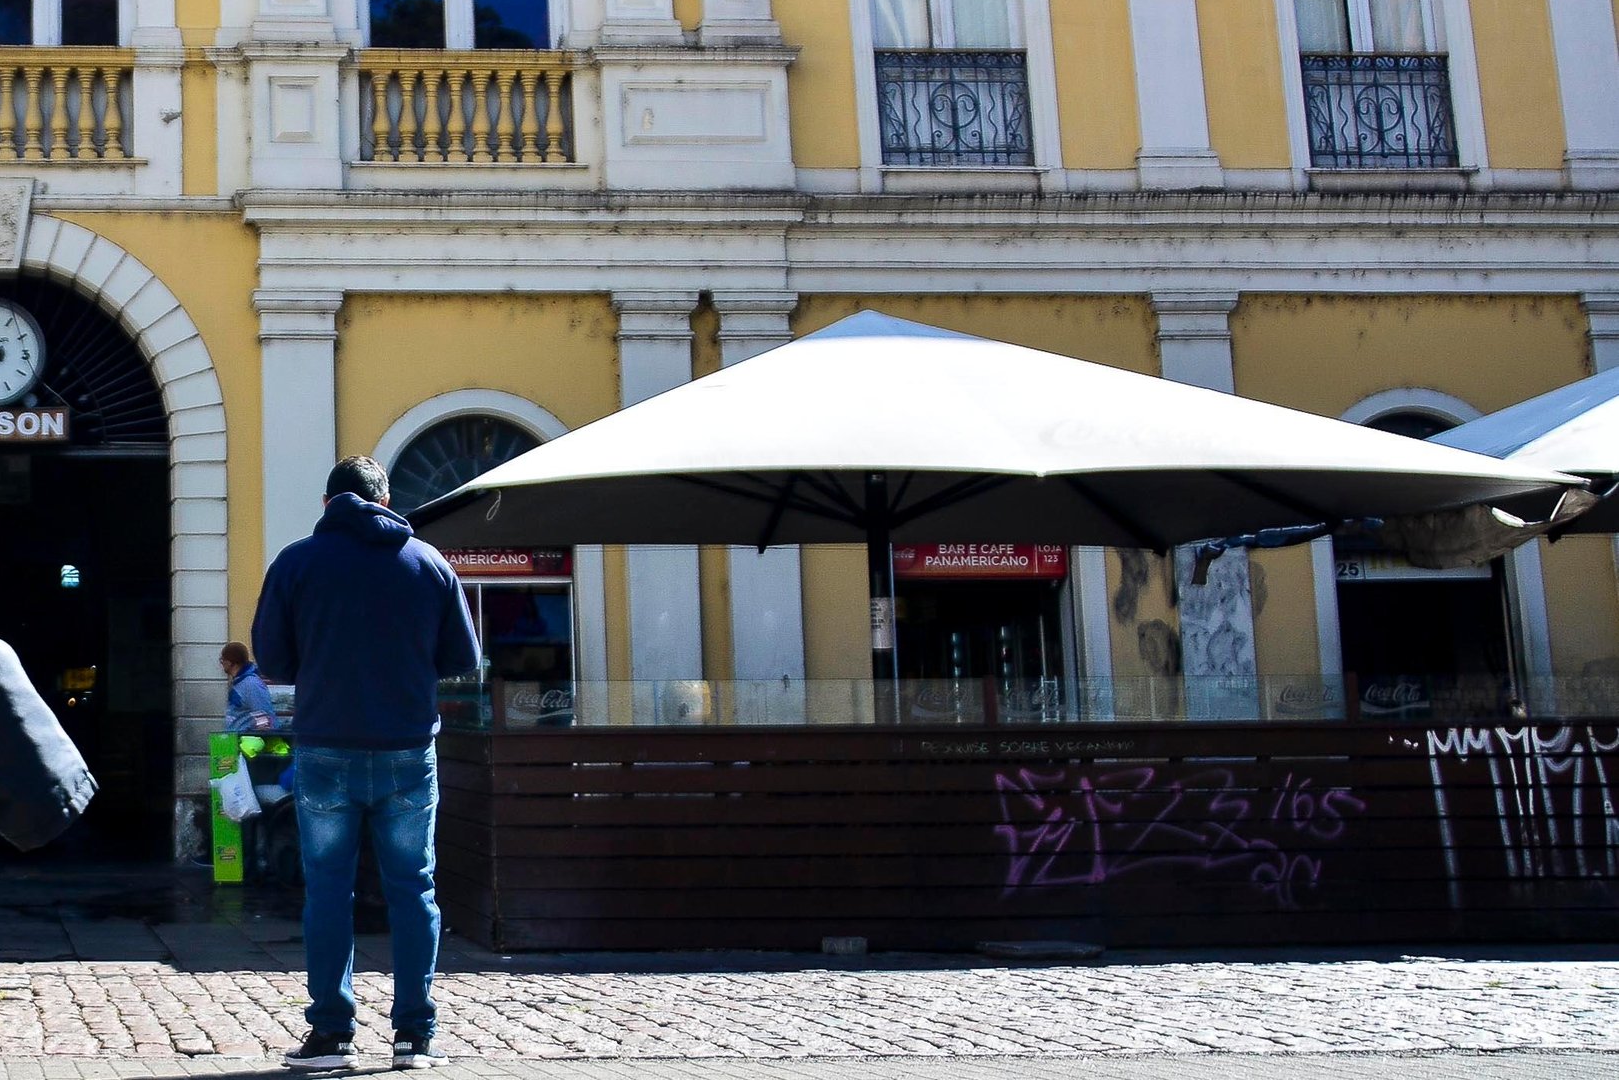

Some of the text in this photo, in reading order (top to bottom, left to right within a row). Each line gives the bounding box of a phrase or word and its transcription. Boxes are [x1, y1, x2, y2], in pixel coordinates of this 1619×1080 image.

[21, 349, 30, 360] 3
[939, 544, 965, 554] BAR
[969, 544, 978, 554] E
[1038, 544, 1063, 553] LOJA
[445, 553, 529, 565] AMERICANO
[925, 555, 1029, 567] PANAMERICANO
[1044, 554, 1060, 563] 123
